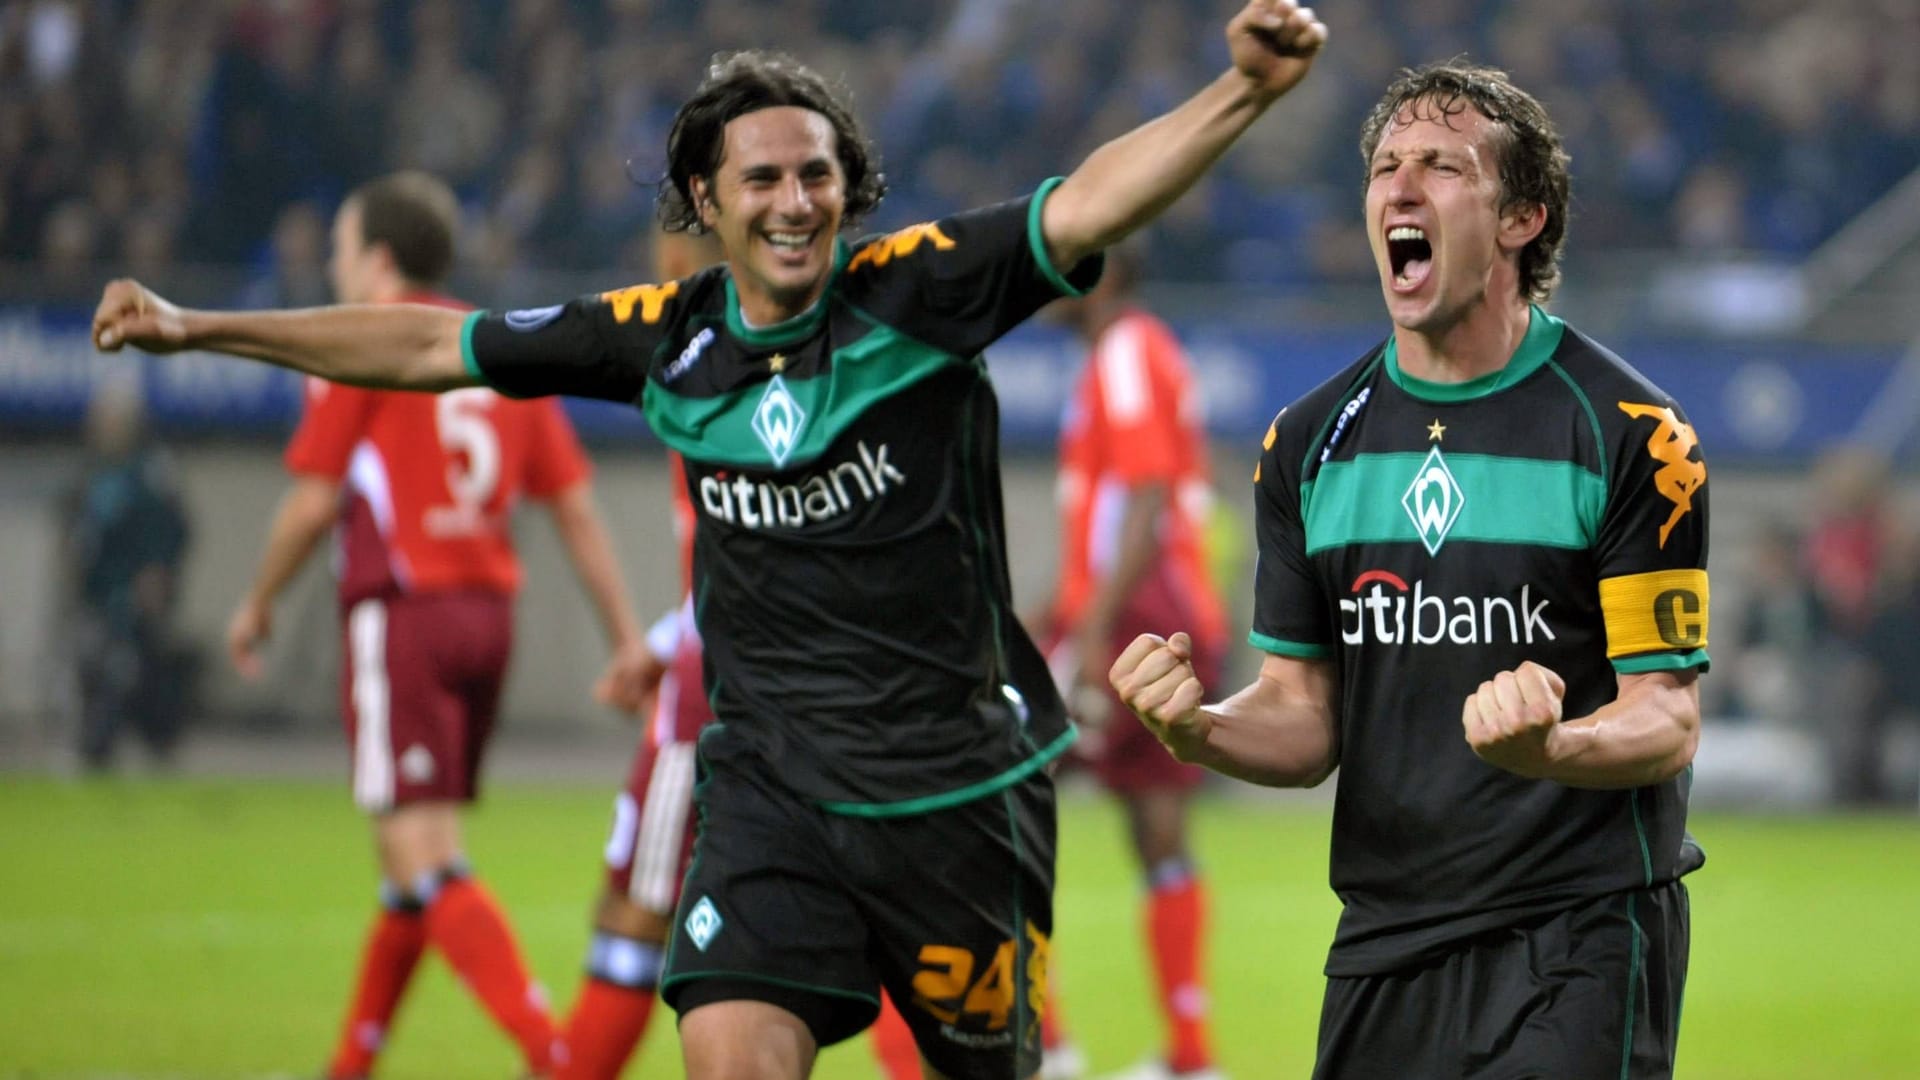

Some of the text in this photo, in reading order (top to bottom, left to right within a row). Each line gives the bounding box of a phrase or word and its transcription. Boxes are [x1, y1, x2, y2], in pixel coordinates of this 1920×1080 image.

[435, 386, 500, 504] 5
[1320, 387, 1370, 462] Kppa
[700, 440, 906, 528] citibank
[1339, 569, 1557, 645] citibank
[1653, 588, 1701, 648] C
[911, 938, 1018, 1031] 24
